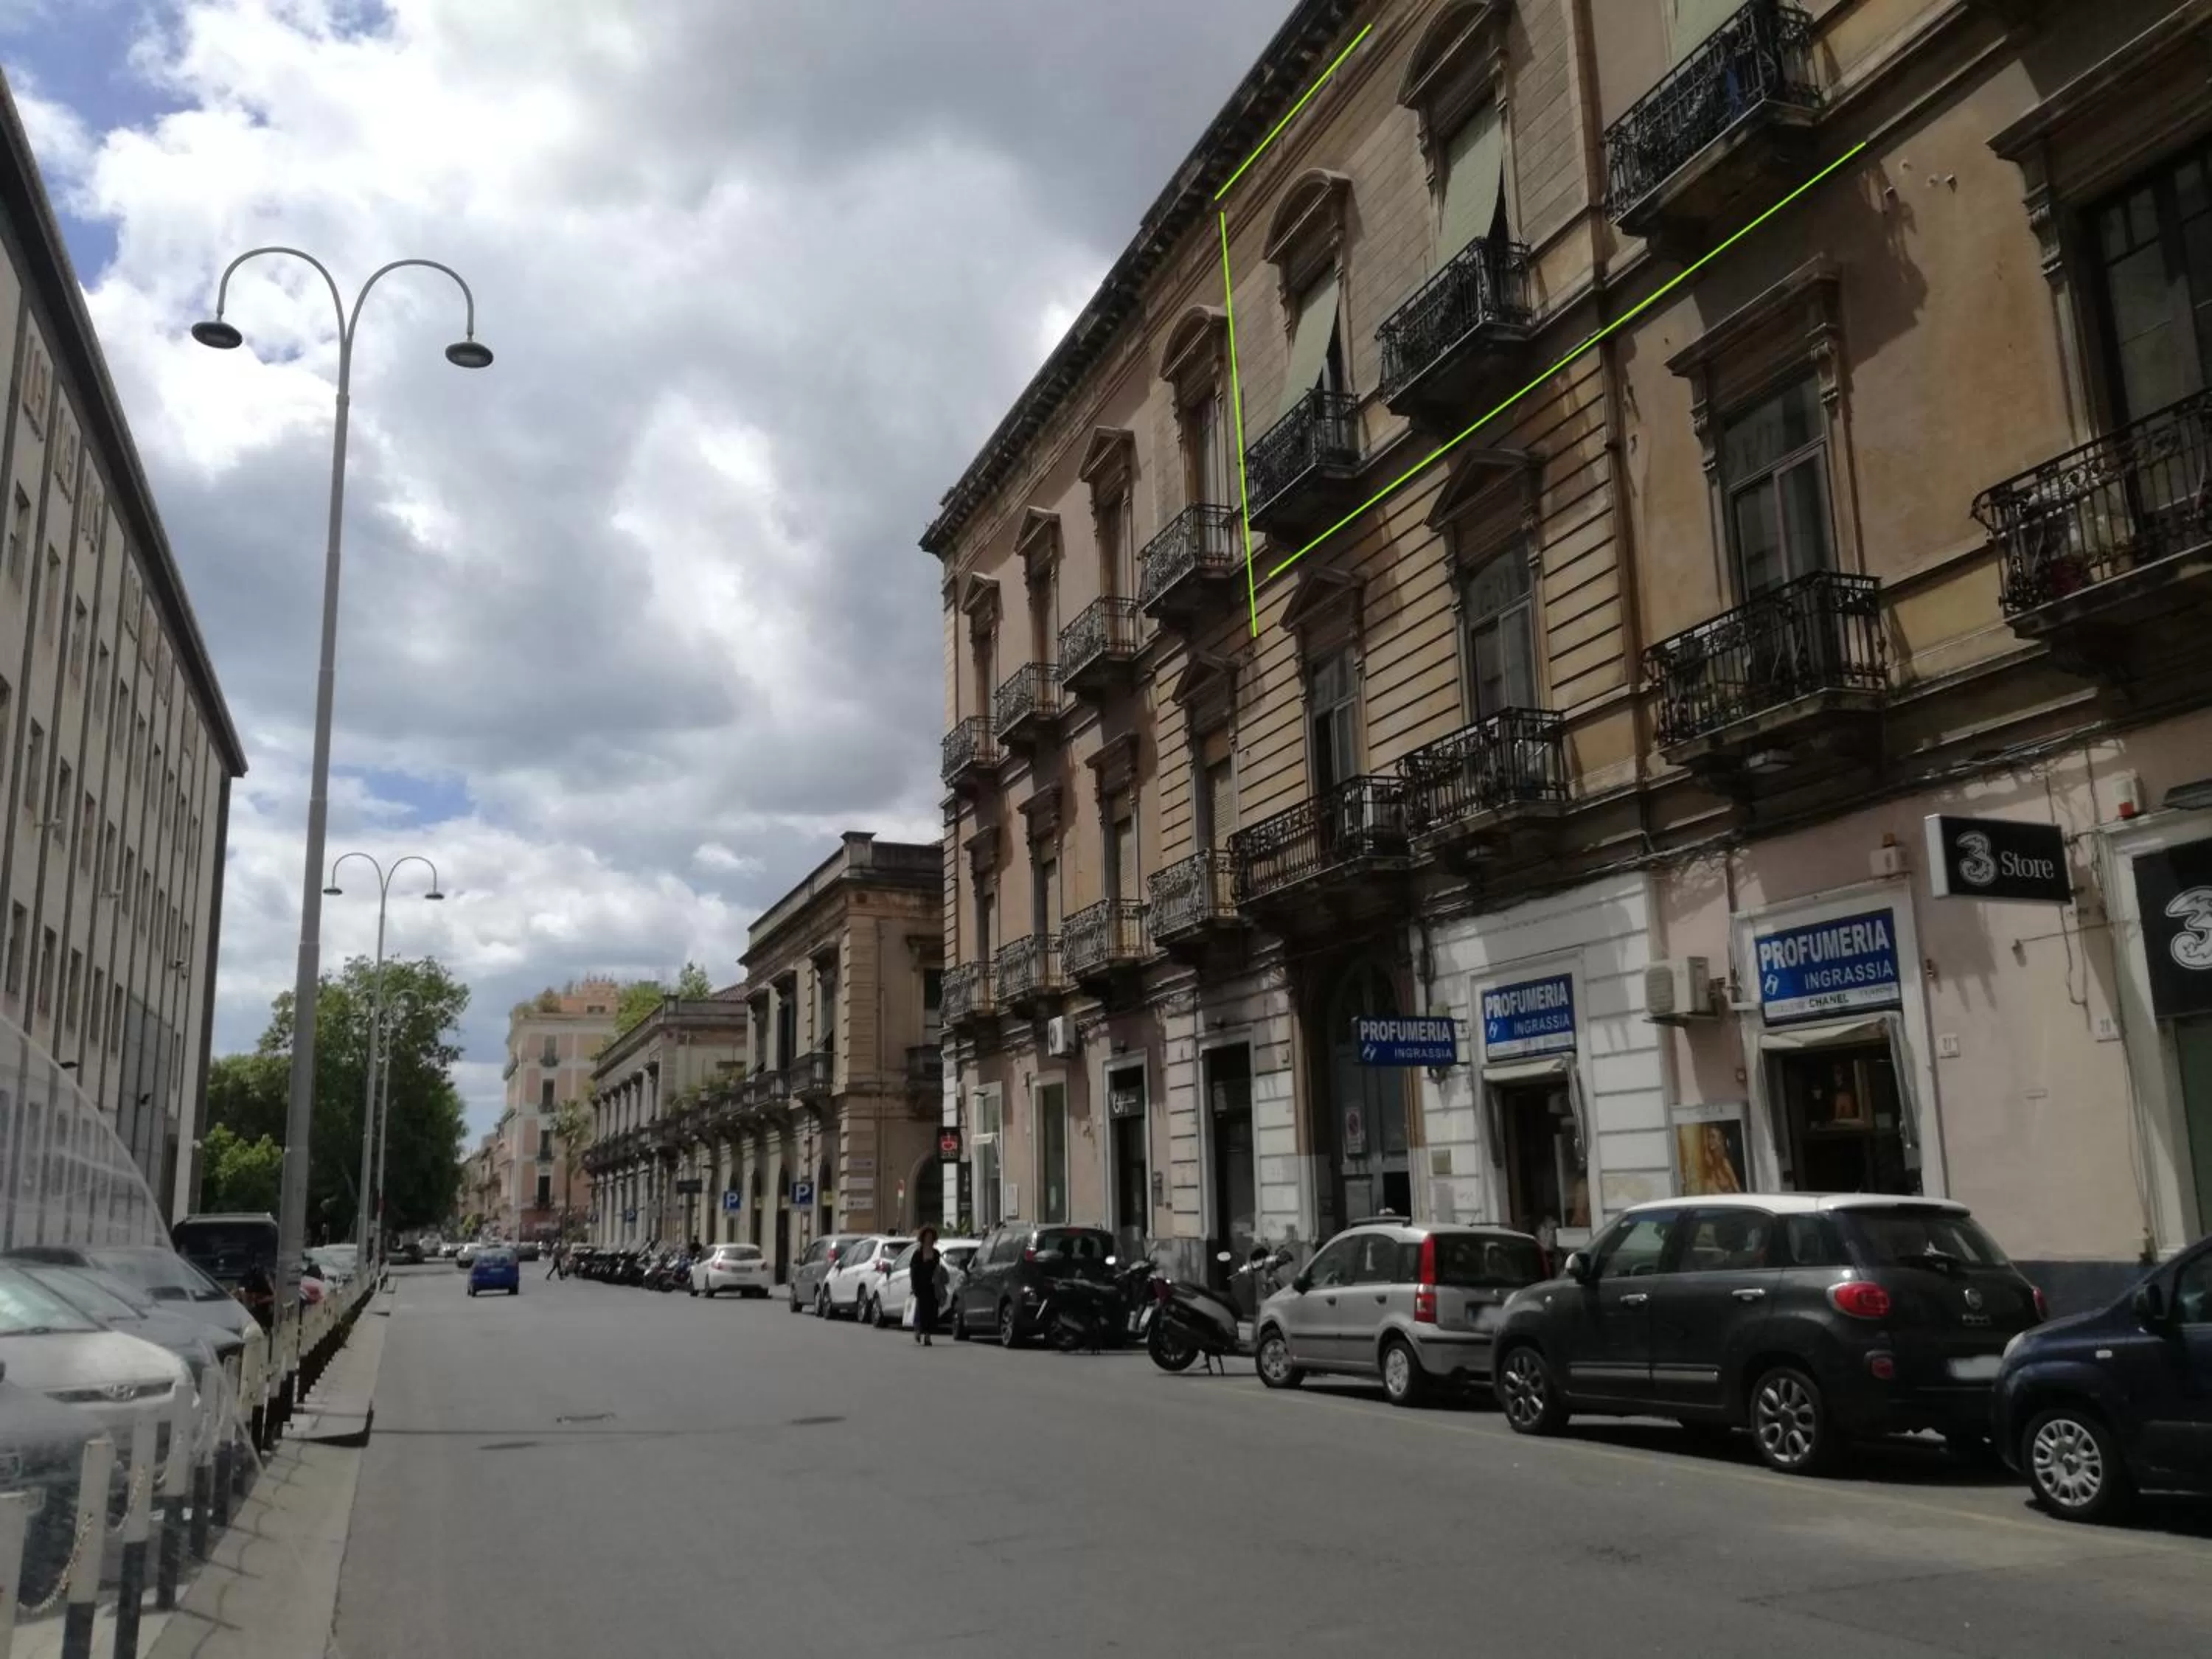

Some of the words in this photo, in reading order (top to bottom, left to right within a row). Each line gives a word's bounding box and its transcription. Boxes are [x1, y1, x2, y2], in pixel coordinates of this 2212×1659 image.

[1956, 830, 1997, 886] 3
[2000, 850, 2055, 879] Store
[1759, 919, 1891, 971] PROFUMERIA
[1804, 959, 1894, 989] INGRASSIA
[1484, 981, 1570, 1020] PROFUMERIA
[1808, 993, 1850, 1007] CHANEL
[1360, 1020, 1452, 1042] PROFUMERIA
[1513, 1013, 1571, 1035] INGRASSIA
[1394, 1048, 1453, 1059] INGRASSIA
[726, 1192, 738, 1208] P
[796, 1183, 810, 1203] P
